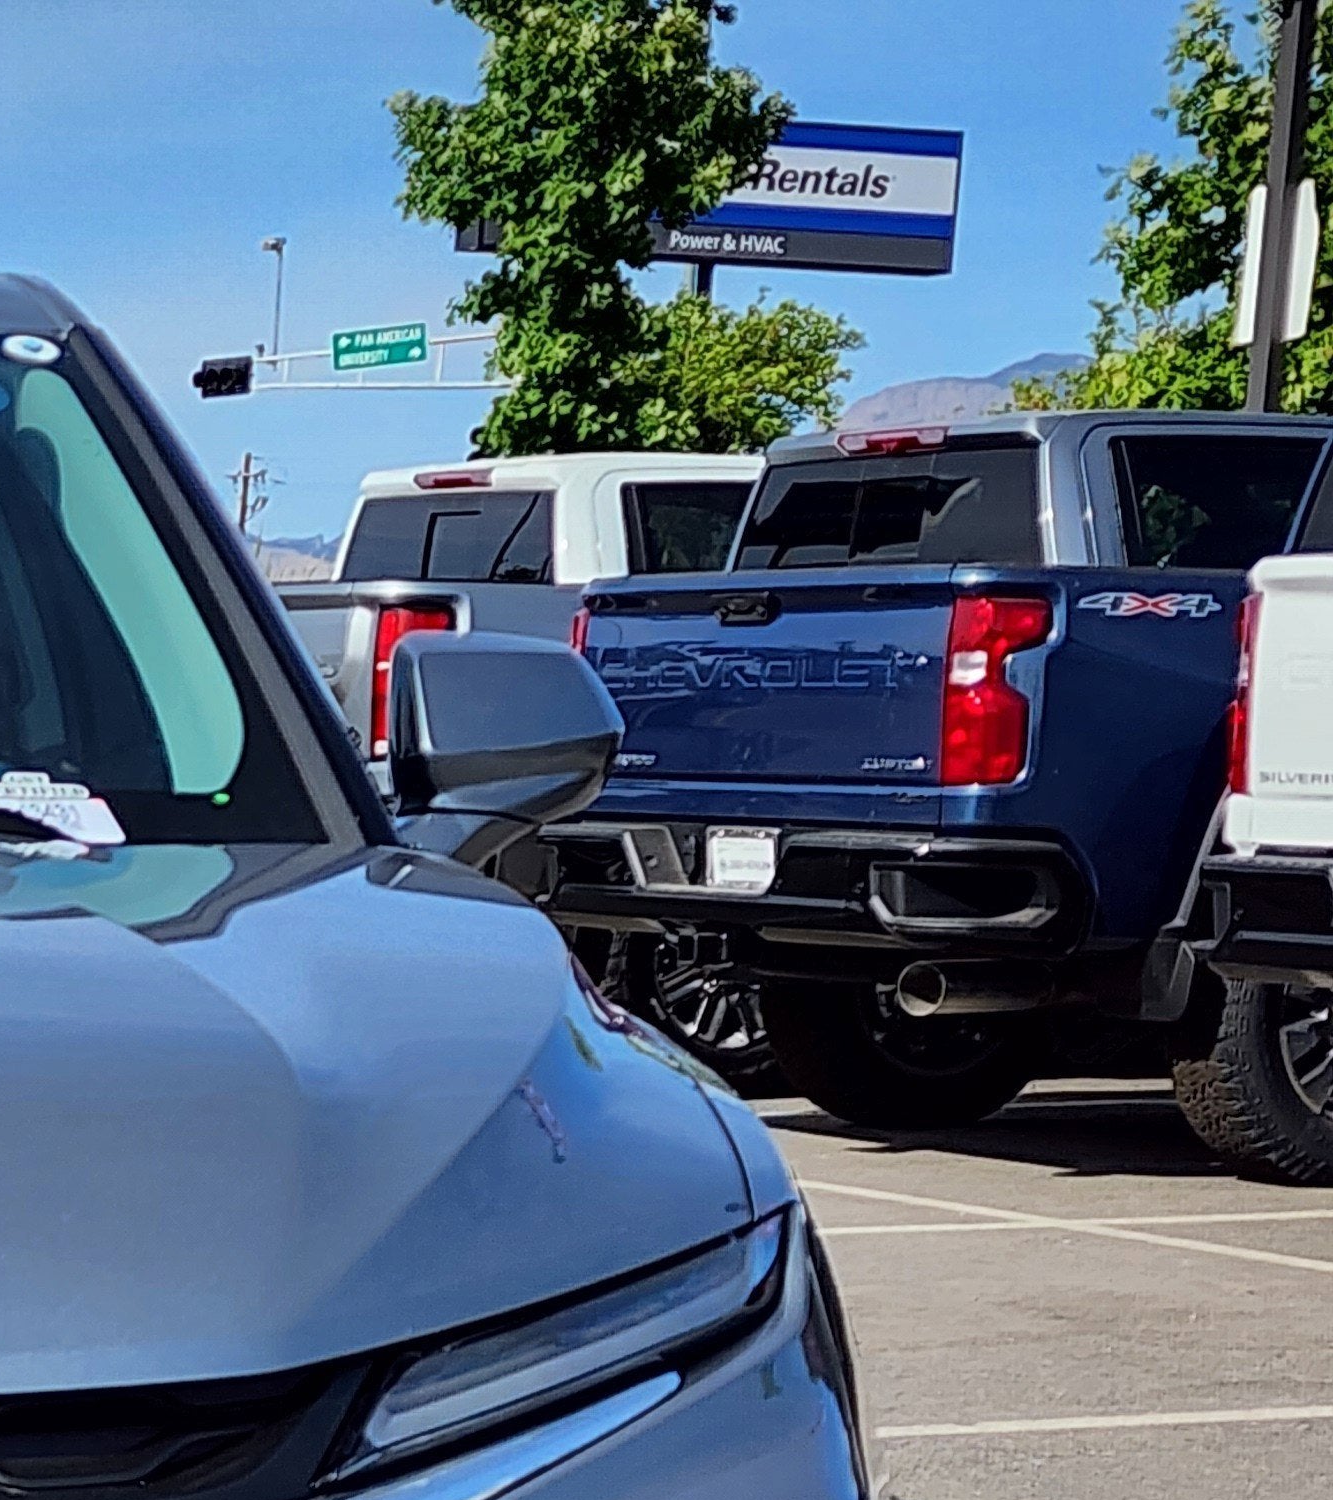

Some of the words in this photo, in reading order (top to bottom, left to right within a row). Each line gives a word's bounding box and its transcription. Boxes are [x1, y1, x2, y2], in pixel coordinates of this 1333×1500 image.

[751, 158, 890, 199] Rentals
[669, 230, 721, 251] Power
[722, 233, 737, 252] &
[739, 234, 785, 254] HVAC
